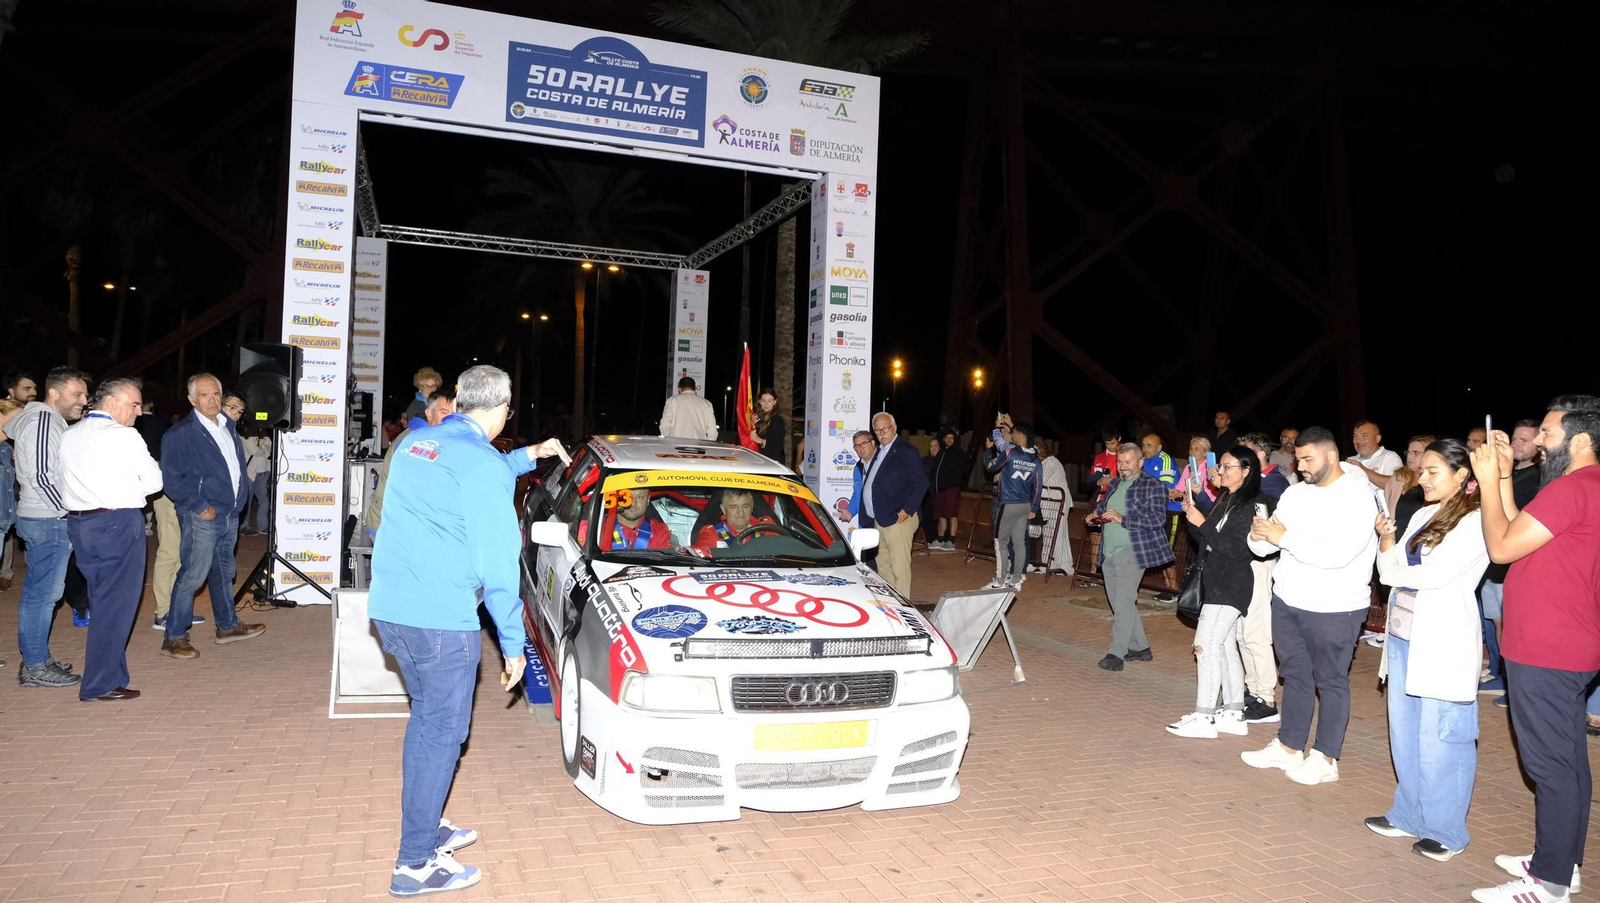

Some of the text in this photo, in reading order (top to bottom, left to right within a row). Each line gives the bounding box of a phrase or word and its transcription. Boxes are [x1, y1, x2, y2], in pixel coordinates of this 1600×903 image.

[390, 70, 450, 88] CERA
[527, 64, 690, 106] 50 RALLYE
[401, 90, 438, 103] Recalvi
[526, 88, 686, 120] COSTA DE ALMERÍA
[313, 128, 347, 136] MICHELIN
[740, 128, 780, 141] COSTA DE
[730, 137, 780, 153] ALMERÍA
[810, 139, 863, 154] DIPUTACIÓN
[810, 149, 860, 163] DE ALMERÍA
[300, 160, 346, 174] Rallycar
[306, 184, 338, 194] Recalvi
[310, 205, 344, 213] MICHELIN
[296, 238, 343, 251] Rallycar
[303, 261, 334, 270] Recalvi
[293, 315, 340, 328] Rallycar
[830, 312, 867, 322] gasolia
[300, 338, 331, 347] Recalvi
[829, 354, 866, 366] Phonika
[301, 394, 336, 405] allycar
[302, 414, 328, 423] ecalvi
[287, 472, 334, 483] Rallycar
[746, 479, 782, 488] ALMERÍA
[294, 495, 325, 503] Recalvi
[604, 489, 633, 509] 53
[285, 552, 331, 562] Rallycar
[291, 574, 322, 582] Realvi
[608, 586, 629, 613] dj tuning
[573, 565, 636, 667] Audi quattro
